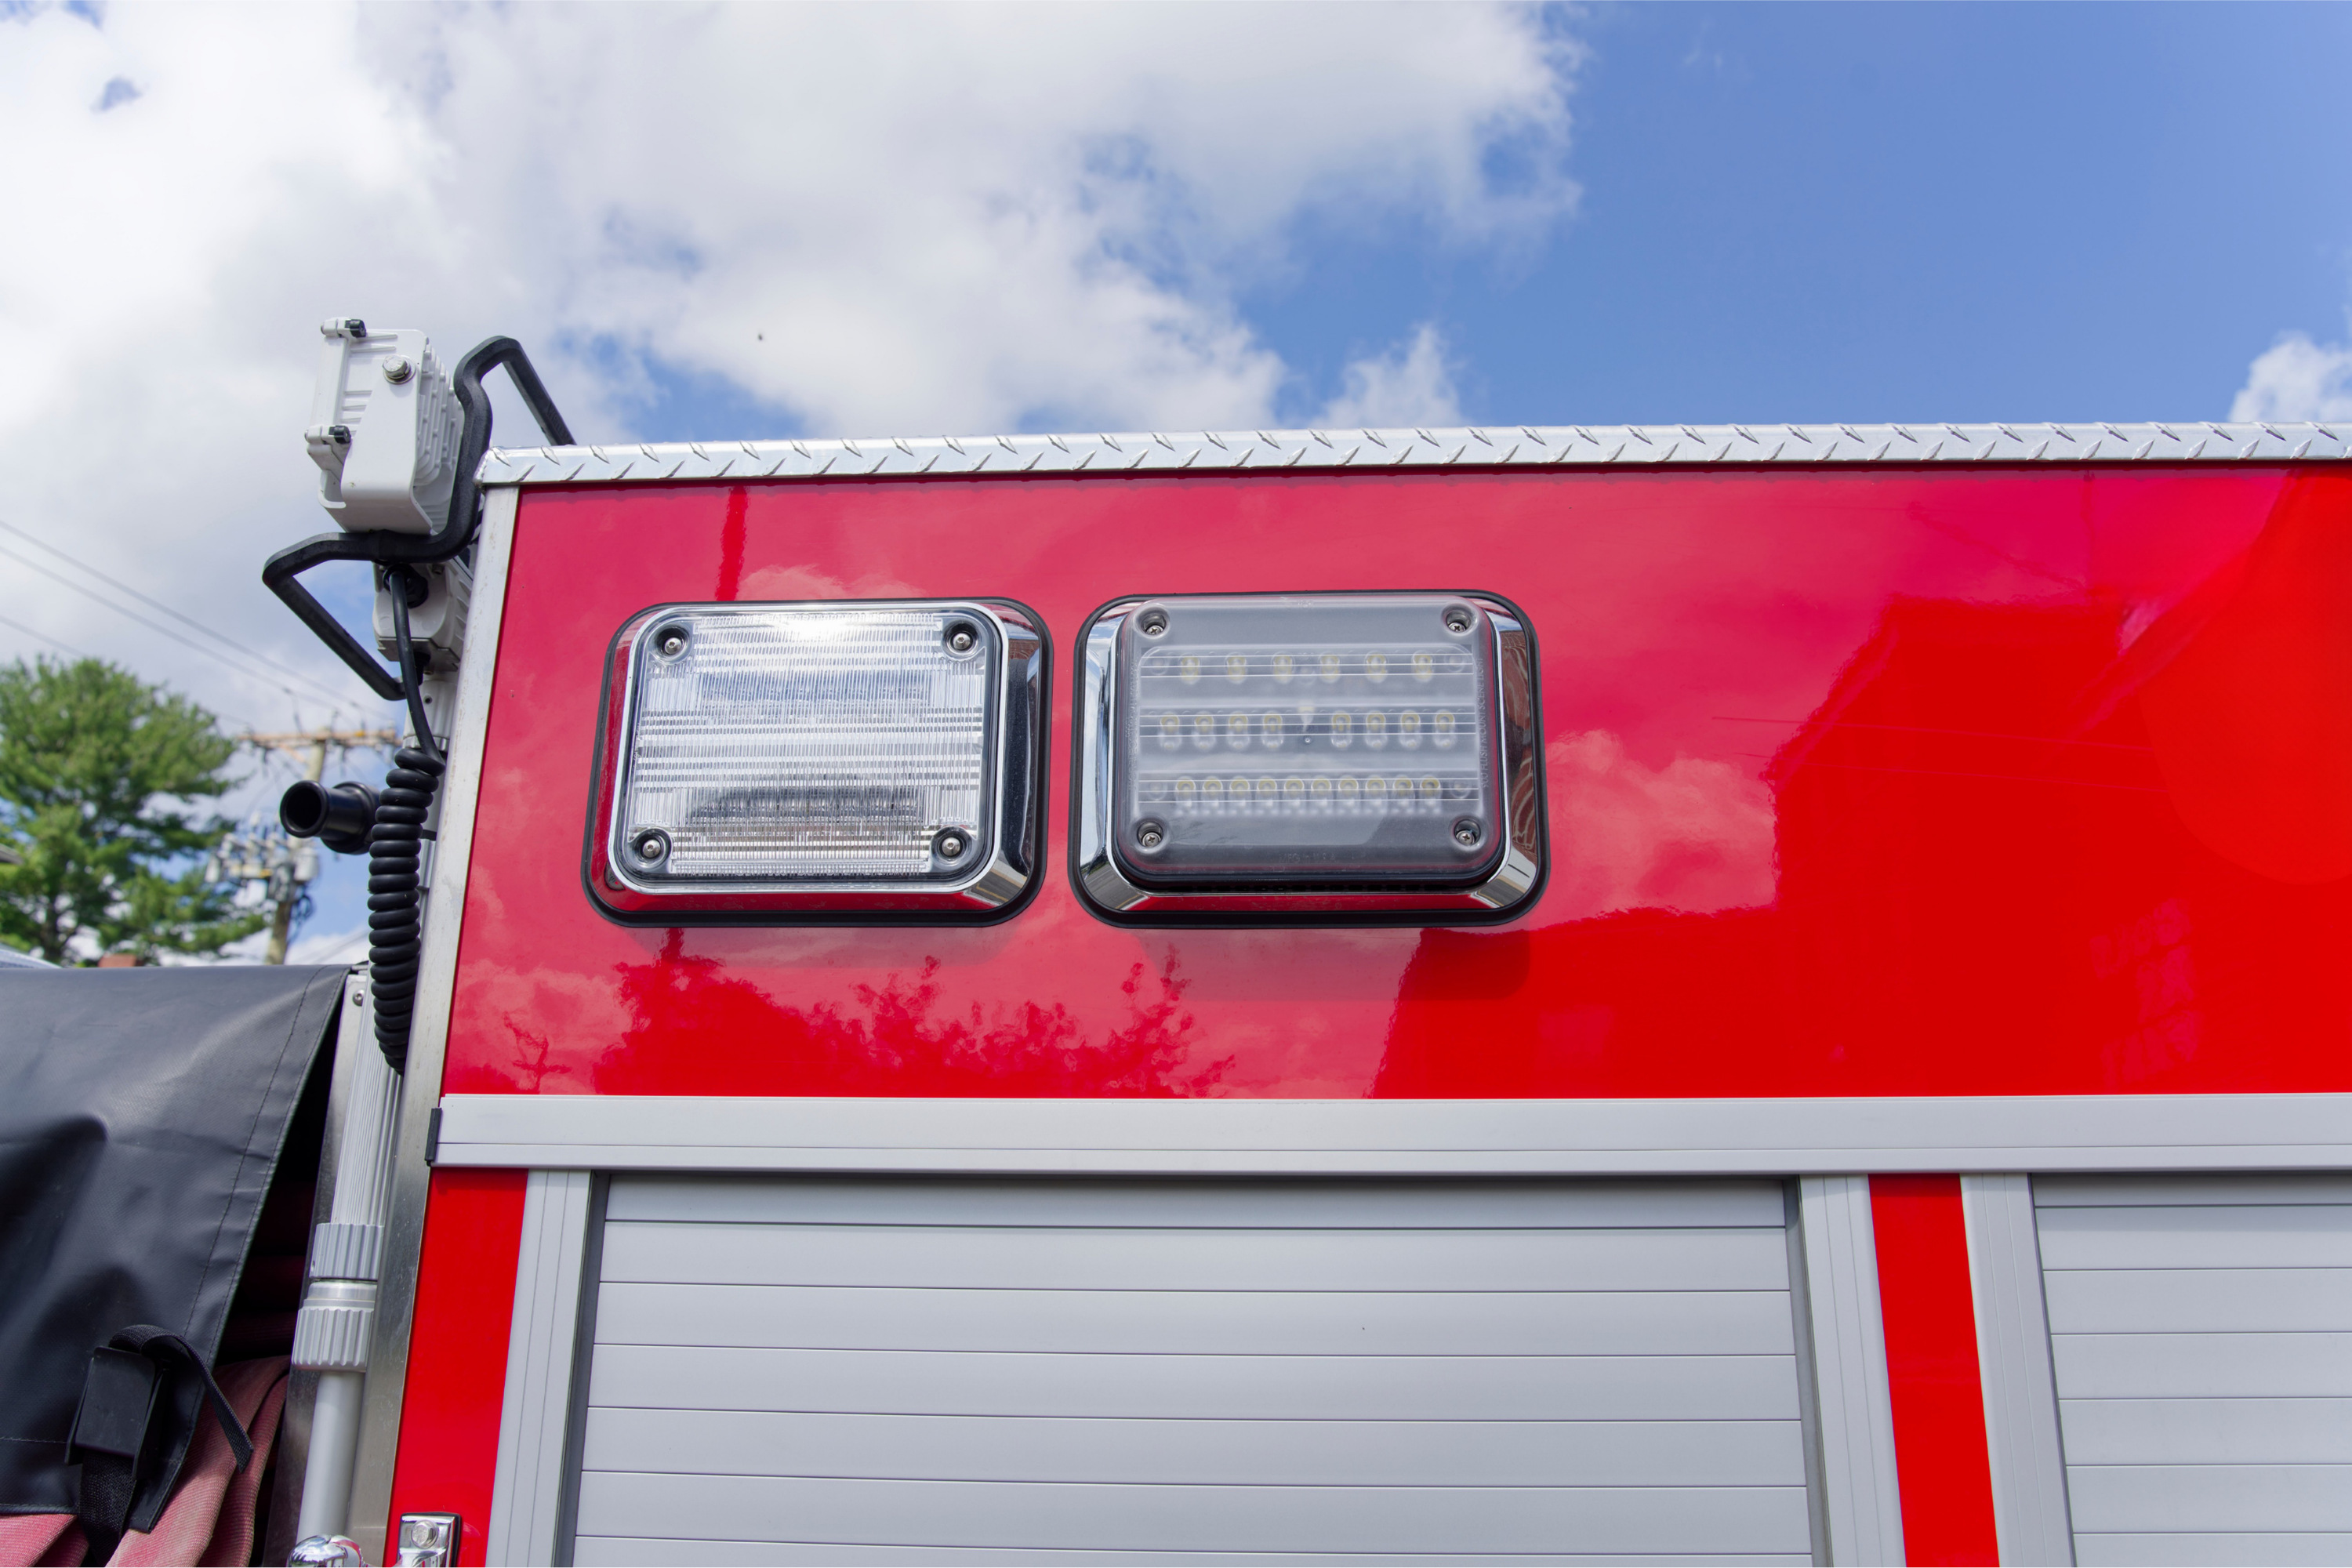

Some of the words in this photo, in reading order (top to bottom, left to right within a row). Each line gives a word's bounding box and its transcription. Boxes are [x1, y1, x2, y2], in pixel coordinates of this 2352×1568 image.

[1475, 657, 1484, 681] LIGHT
[1476, 682, 1486, 710] SCENE
[1478, 712, 1487, 743] MOUNT
[1479, 746, 1489, 771] FLUSH
